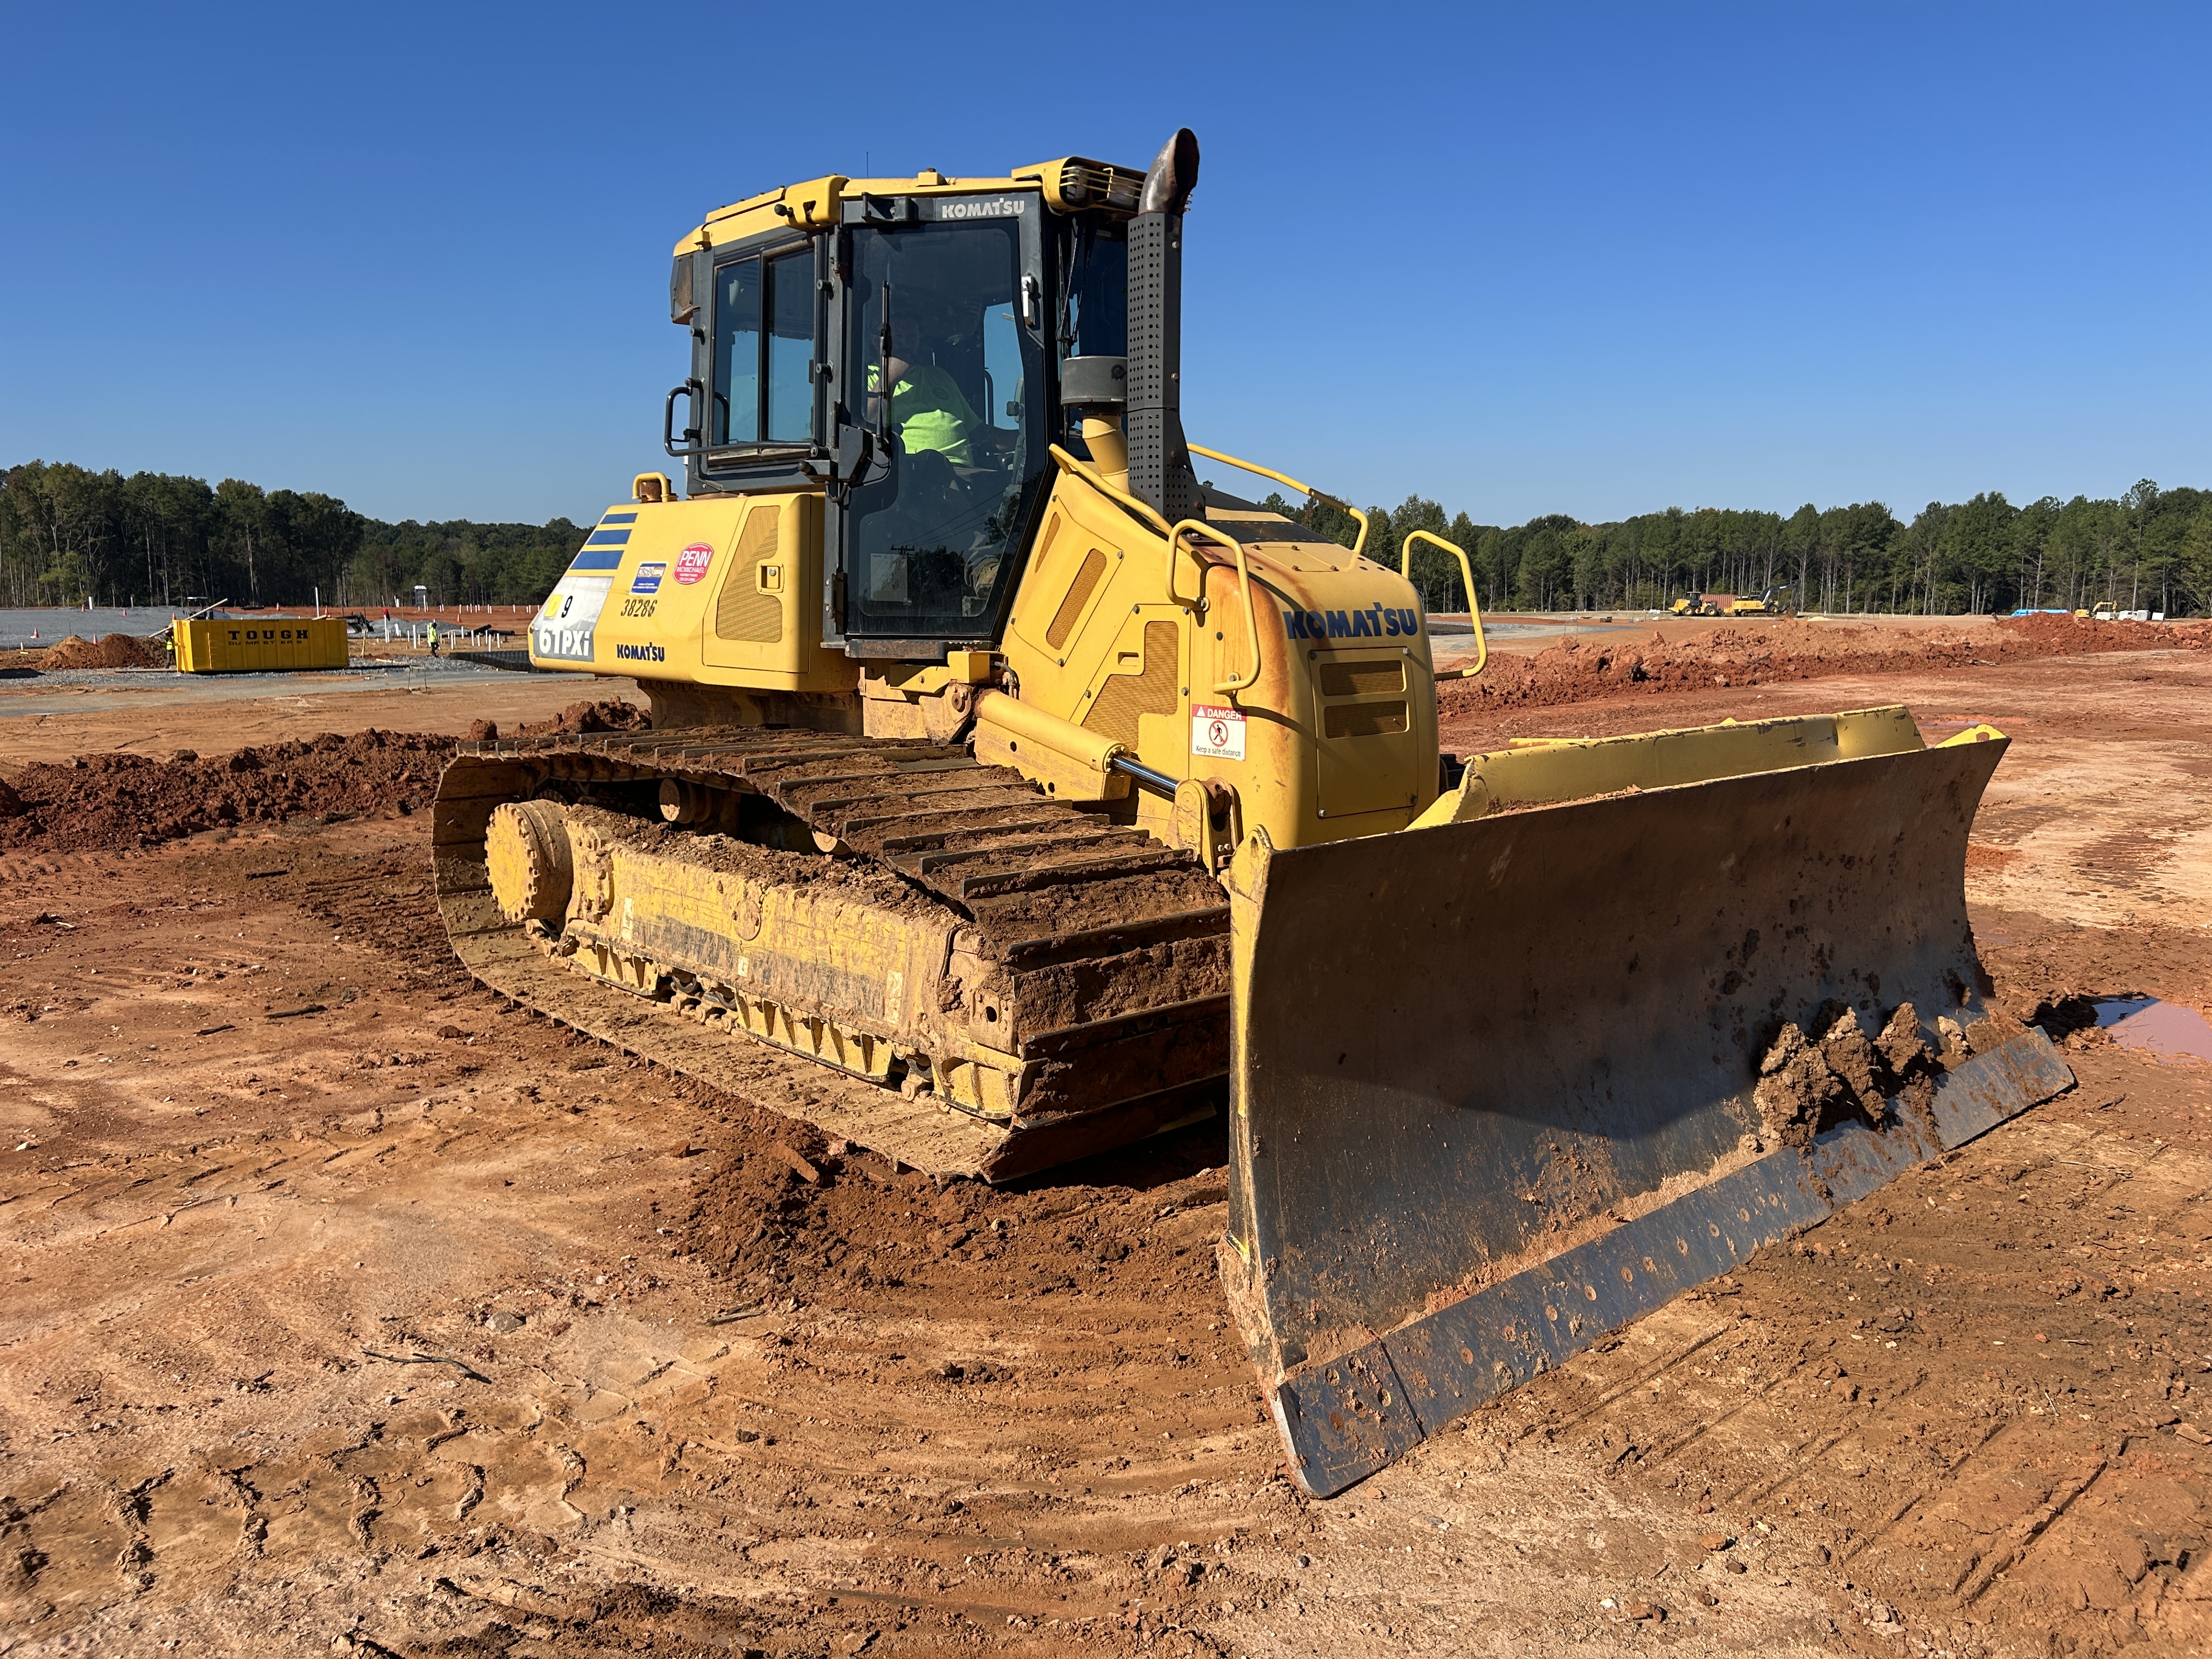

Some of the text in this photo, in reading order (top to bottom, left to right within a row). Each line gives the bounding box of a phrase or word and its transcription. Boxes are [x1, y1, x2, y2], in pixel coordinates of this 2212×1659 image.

[942, 198, 1025, 219] KOMATSU
[679, 550, 712, 567] PENN
[561, 595, 573, 618] 9
[620, 599, 658, 618] 38286
[1282, 602, 1418, 639] KOMATSU
[228, 630, 308, 640] TOUGH
[617, 642, 665, 662] KOMATSU
[1207, 708, 1242, 720] DANGER
[1196, 745, 1207, 754] Keep
[1222, 748, 1241, 757] distance
